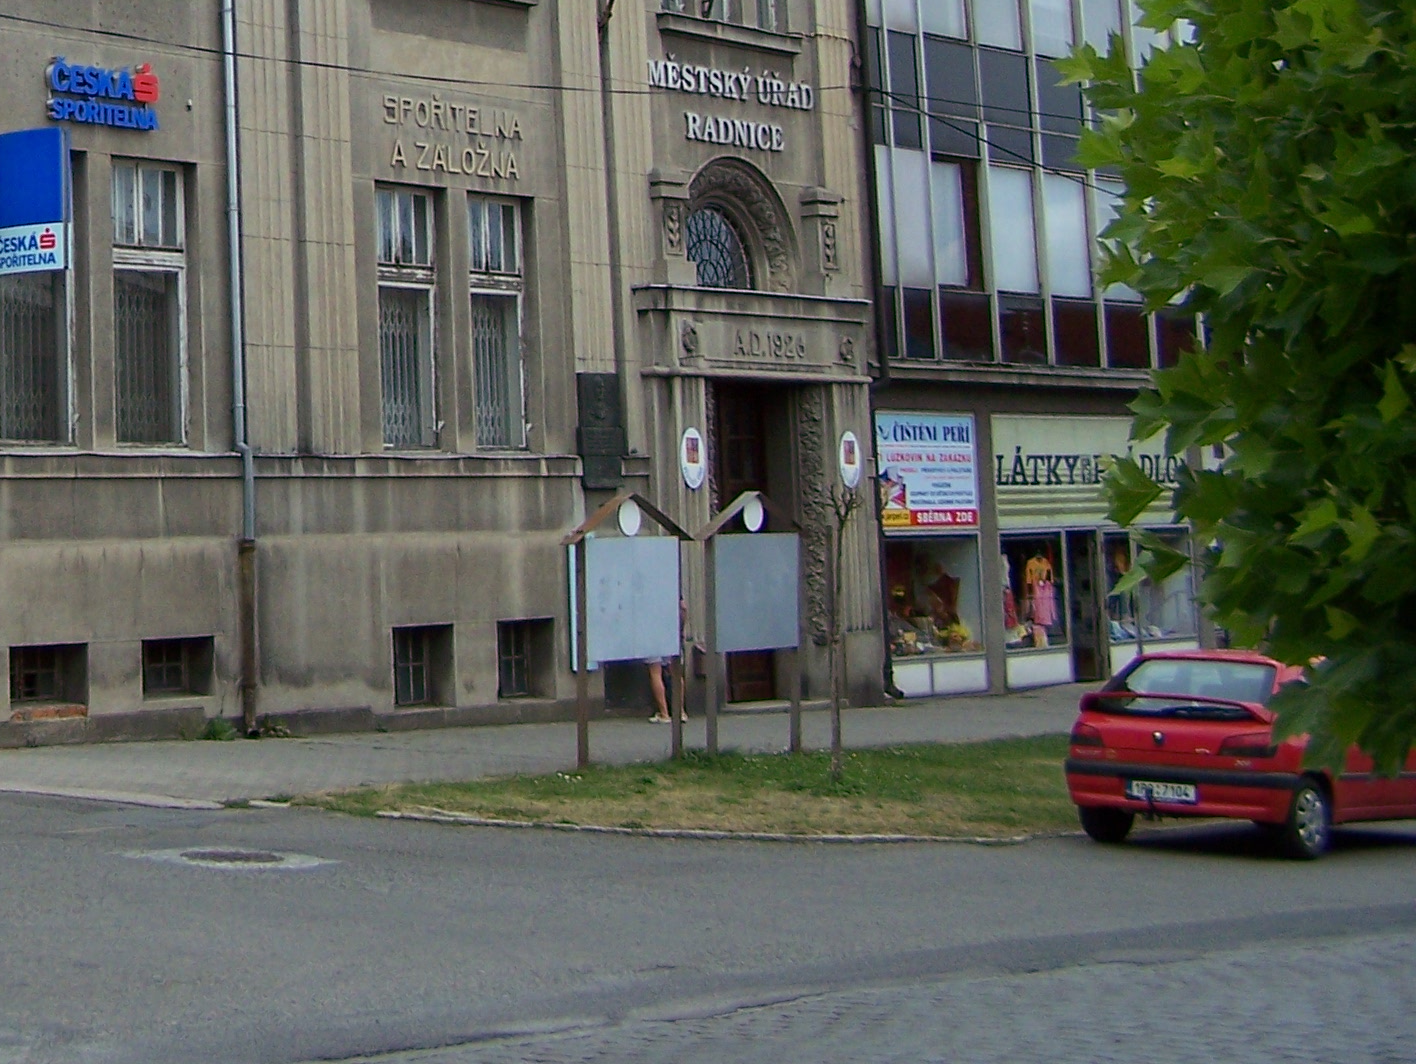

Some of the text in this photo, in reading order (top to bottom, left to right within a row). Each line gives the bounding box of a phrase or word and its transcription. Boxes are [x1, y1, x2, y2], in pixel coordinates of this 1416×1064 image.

[648, 53, 752, 102] MĚSTSKÝ
[50, 96, 160, 131] SPOŘITELNA
[383, 93, 524, 141] SPOŘITELNA
[685, 112, 785, 152] RADNICE
[391, 139, 521, 180] A ZÁLOŽNA
[995, 445, 1079, 485] LÁTKY
[955, 512, 974, 523] ZDE
